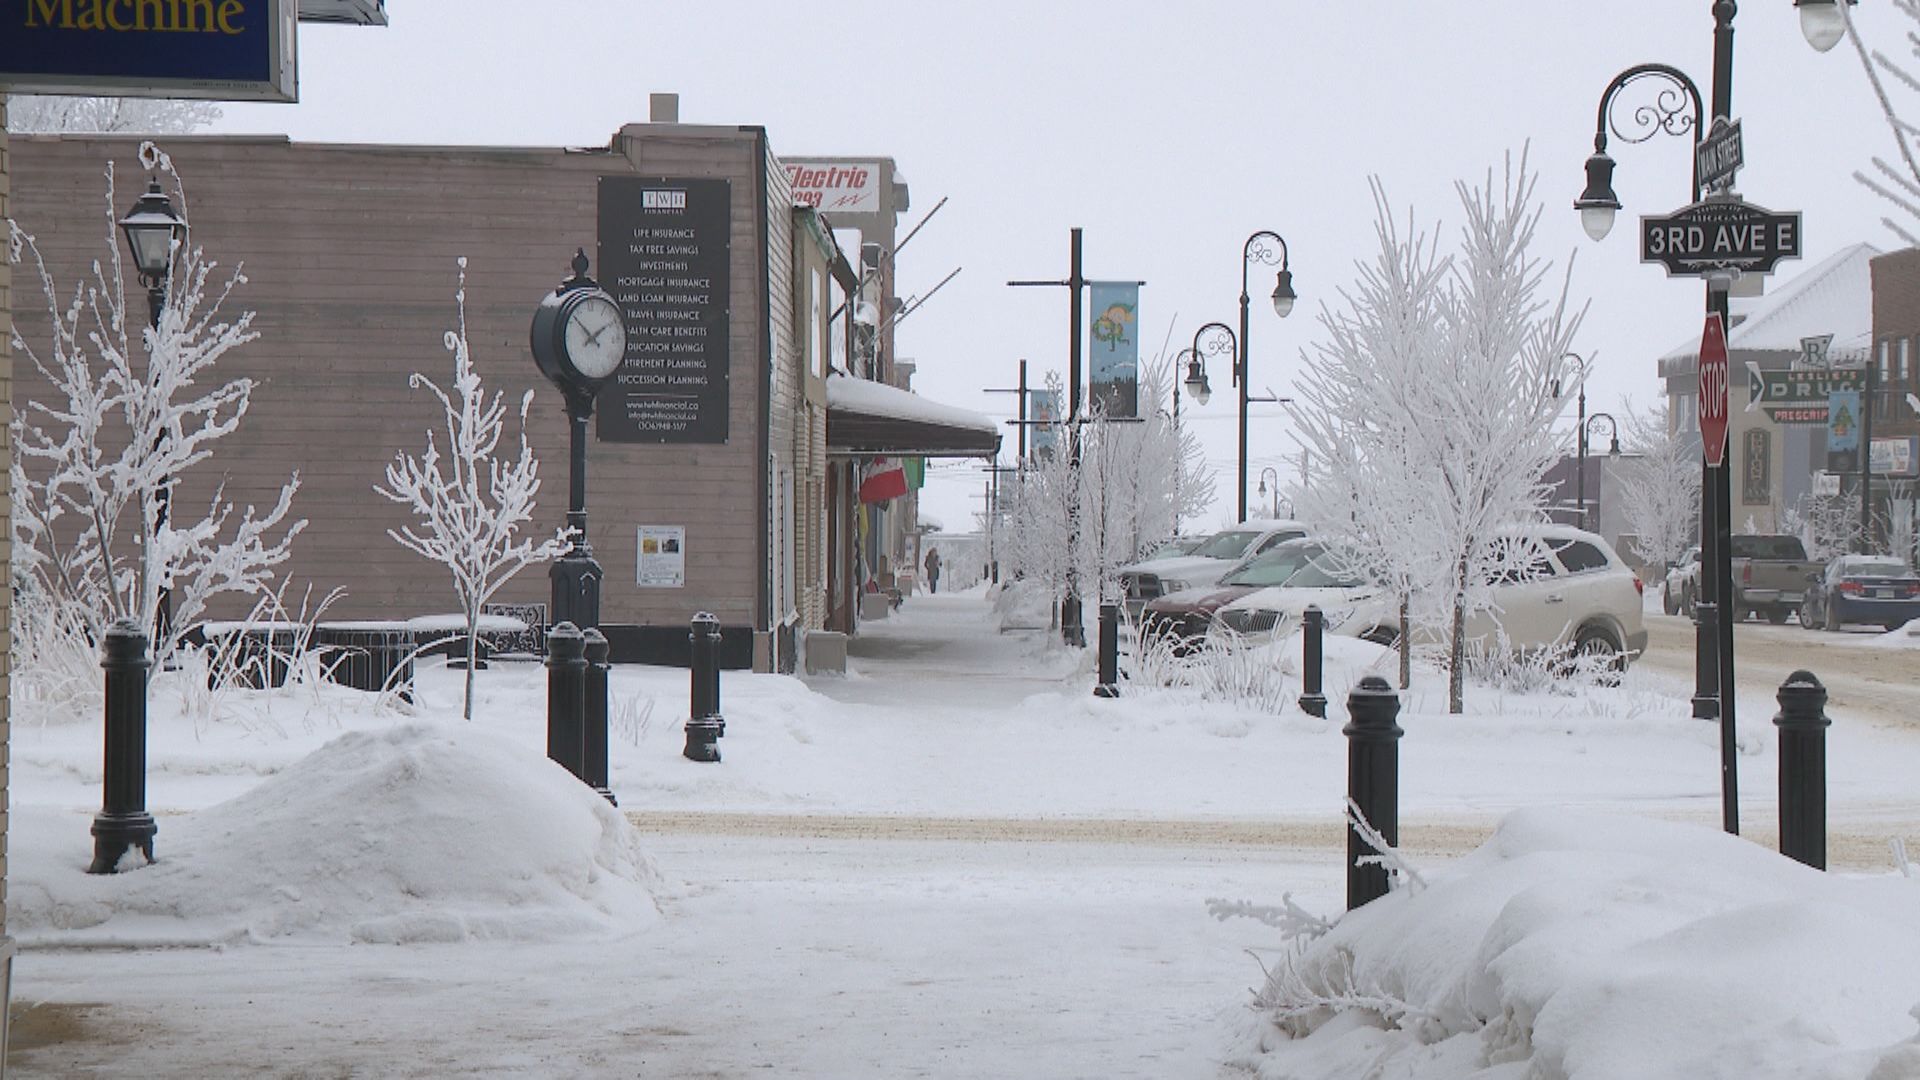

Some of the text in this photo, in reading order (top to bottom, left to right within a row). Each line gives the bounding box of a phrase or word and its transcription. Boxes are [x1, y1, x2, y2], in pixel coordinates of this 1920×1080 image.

[25, 0, 245, 35] Machine
[1700, 133, 1740, 180] MAIN STREET
[646, 192, 684, 206] TWH
[633, 229, 695, 239] LIFE INSURANCE
[1649, 223, 1793, 254] 3RD AVE E
[629, 245, 699, 255] TAX FREE SAVINGS
[640, 261, 688, 271] INVESTMENTS
[617, 277, 710, 288] MORTGAGE INSURANCE
[618, 293, 709, 304] LAND LOAN INSURANCE
[627, 309, 700, 320] TRAVEL INSURANCE
[627, 326, 707, 337] ALTH CARE BENEFITS
[627, 343, 704, 353] DUCATION SAVINGS
[624, 359, 707, 369] ETIREMENT PLANNING
[617, 375, 708, 385] SUCCESSION PLANNING
[1788, 371, 1857, 382] LESLIE'S
[1700, 361, 1727, 419] STOP
[1774, 408, 1829, 422] PRESCRIP
